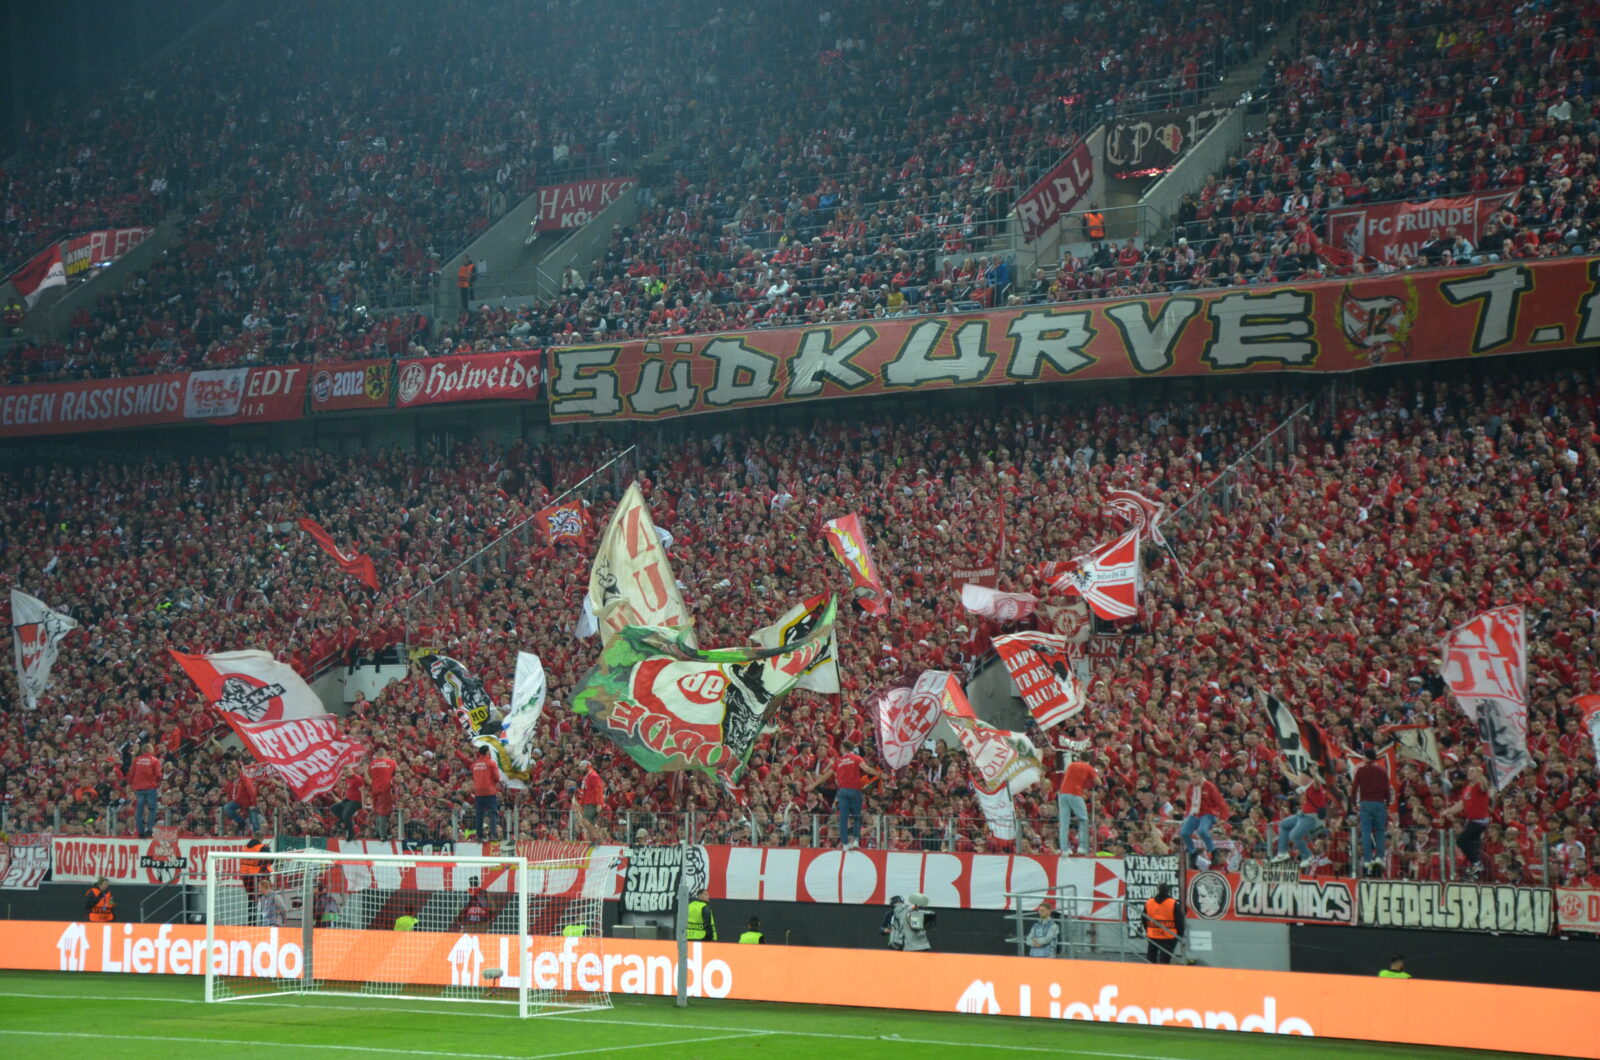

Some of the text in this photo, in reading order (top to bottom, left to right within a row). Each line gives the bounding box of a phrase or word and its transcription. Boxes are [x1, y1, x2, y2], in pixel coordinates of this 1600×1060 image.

[1017, 157, 1090, 232] RUDL
[560, 208, 593, 228] KÖL
[1368, 217, 1392, 235] FC
[1397, 206, 1473, 232] FRÜNDE
[551, 291, 1317, 416] SÜDKURVE
[333, 370, 364, 396] 2012
[0, 393, 56, 425] EGEN
[60, 381, 181, 421] RASSISMUS
[54, 841, 139, 879] DOMSTADT
[629, 846, 682, 867] SEKTION
[1126, 855, 1179, 870] VIRAGE
[626, 865, 680, 893] STADT
[726, 845, 1127, 921] HORDE
[1262, 870, 1281, 882] CON
[624, 891, 675, 912] VERBOT
[1236, 881, 1352, 921] COLONIACS
[102, 923, 303, 979] Lieferando
[500, 933, 733, 999] Lieferando
